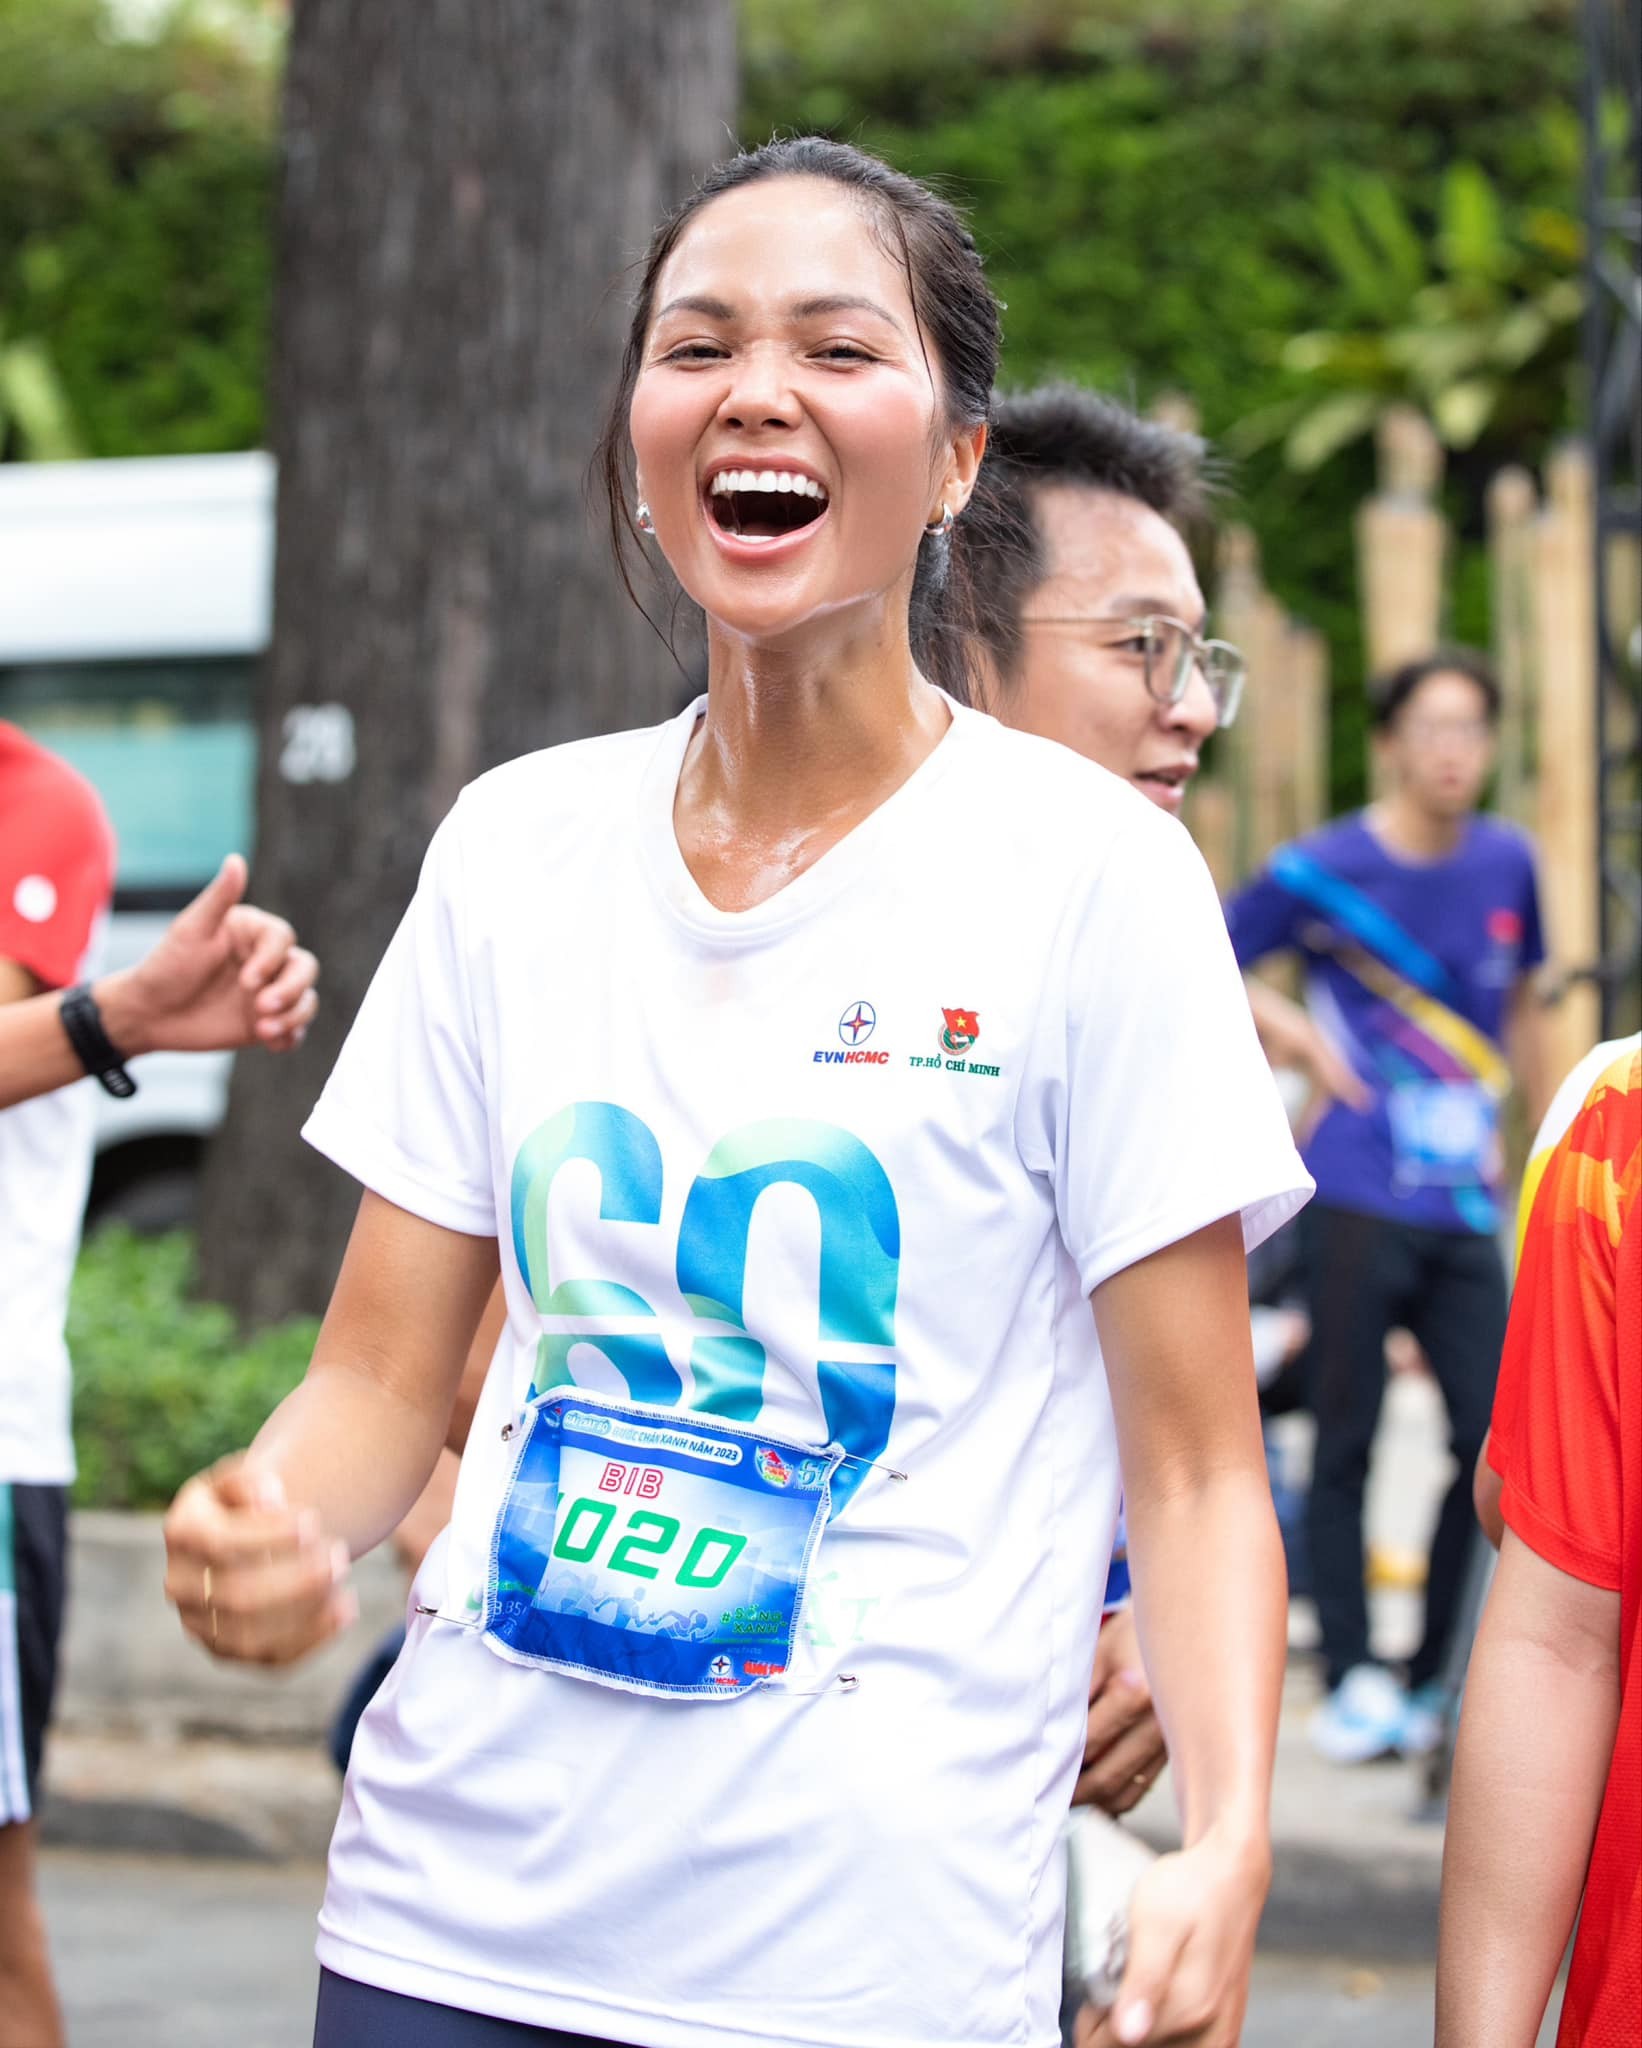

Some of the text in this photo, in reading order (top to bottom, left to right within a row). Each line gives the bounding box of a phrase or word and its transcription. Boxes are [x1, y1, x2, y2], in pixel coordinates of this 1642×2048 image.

[812, 1050, 890, 1065] EVNHCMC
[945, 1058, 966, 1073] CHÍ
[968, 1063, 1000, 1077] MINH
[661, 1434, 688, 1448] XANH
[714, 1447, 738, 1461] 2023
[598, 1462, 664, 1499] BIB
[553, 1492, 748, 1588] 020
[733, 1621, 778, 1634] XANH
